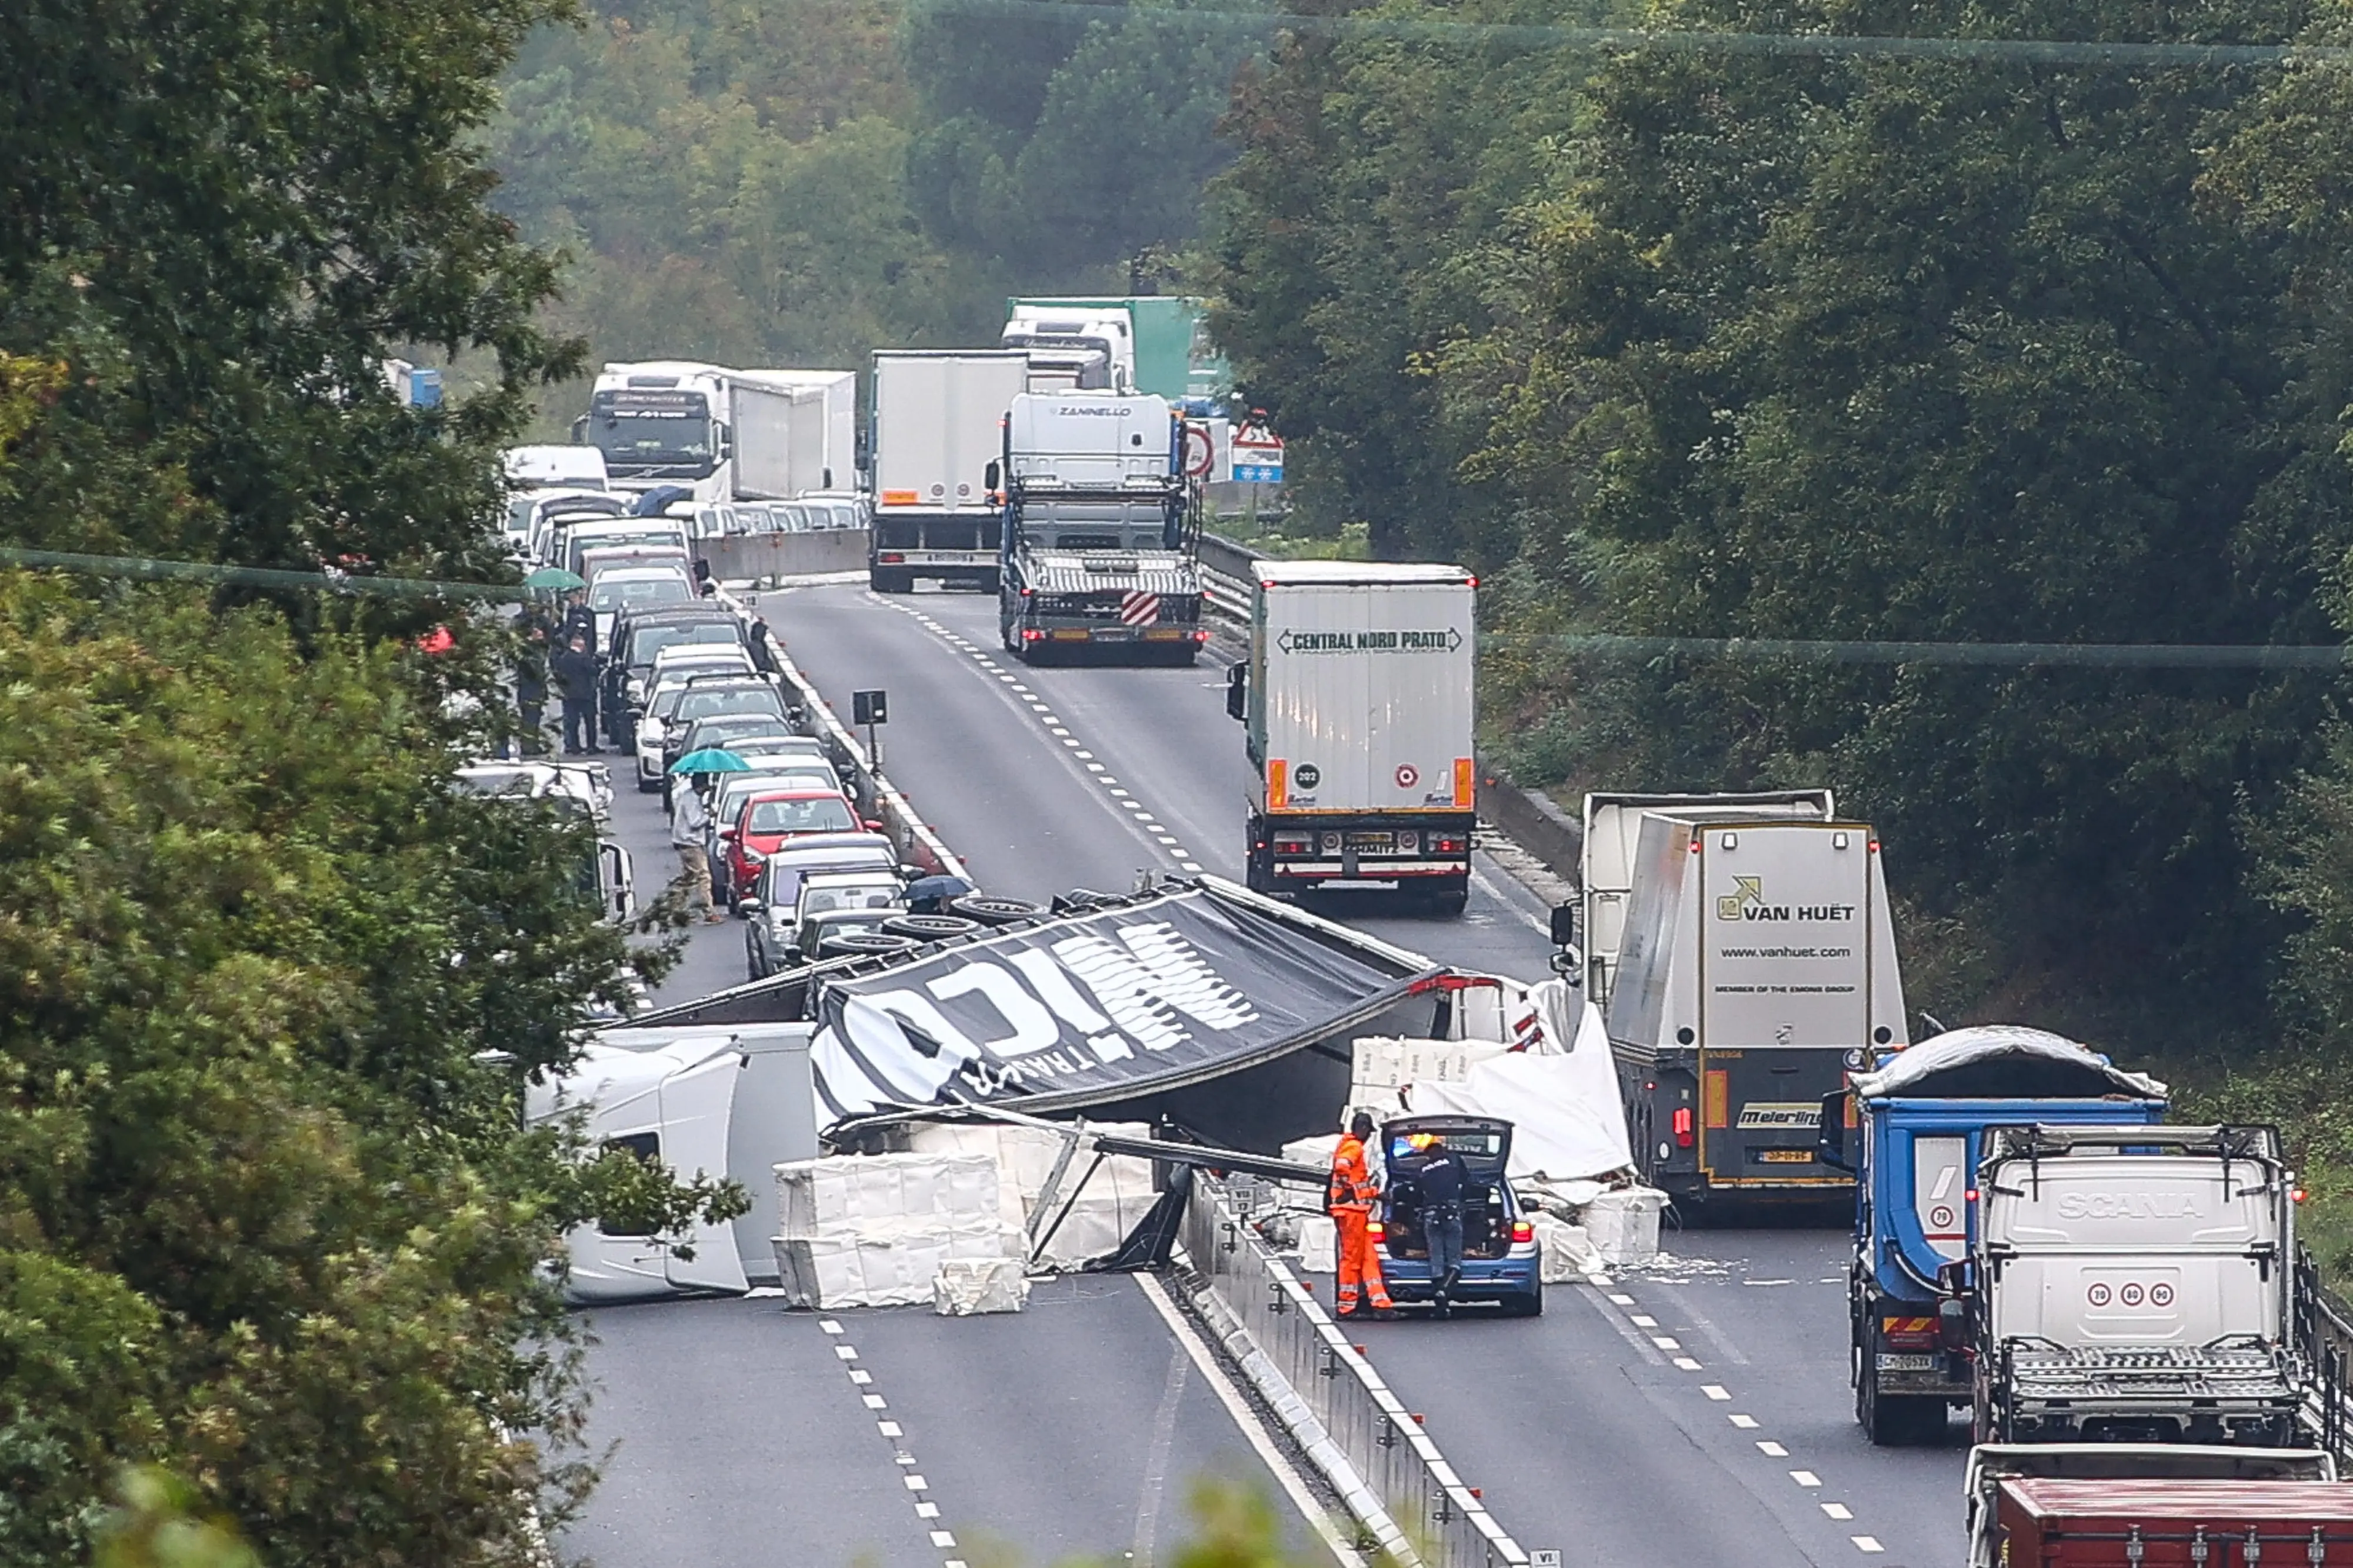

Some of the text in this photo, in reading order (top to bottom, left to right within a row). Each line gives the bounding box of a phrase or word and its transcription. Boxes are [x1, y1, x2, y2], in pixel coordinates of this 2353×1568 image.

[1294, 631, 1446, 649] CENTRAL NORD PRATO
[1743, 906, 1789, 920] VAN
[1798, 903, 1855, 920] HUËT
[1721, 946, 1851, 958] www.vanhuet.com
[2058, 1192, 2205, 1219] SCANIA
[1937, 1212, 1948, 1221] 70
[2094, 1290, 2107, 1300] 70
[2126, 1290, 2139, 1299] 80
[2155, 1290, 2168, 1300] 90
